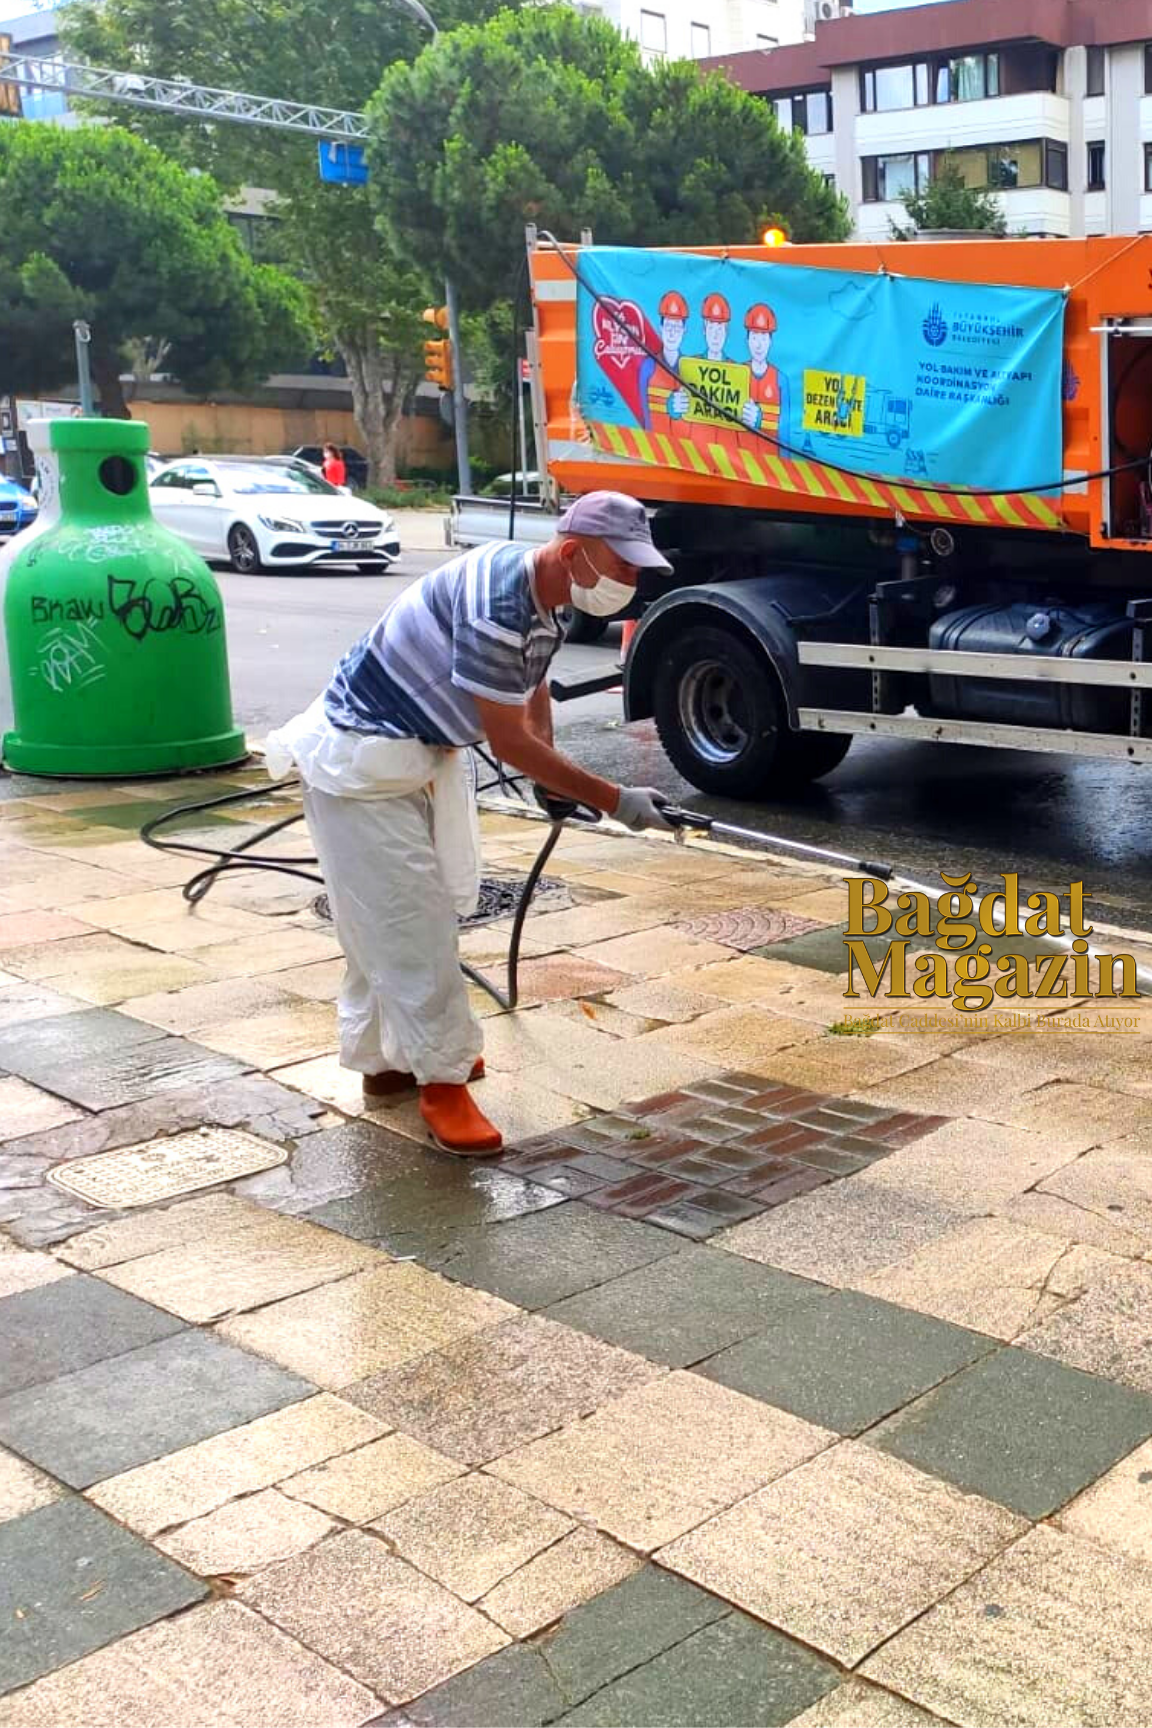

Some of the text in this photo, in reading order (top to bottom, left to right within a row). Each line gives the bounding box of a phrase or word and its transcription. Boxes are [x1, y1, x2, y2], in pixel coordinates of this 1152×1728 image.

[698, 366, 731, 386] YOL
[919, 361, 939, 373] YOL
[941, 364, 973, 376] BAKIM
[975, 368, 989, 379] VE
[824, 376, 846, 394] YO
